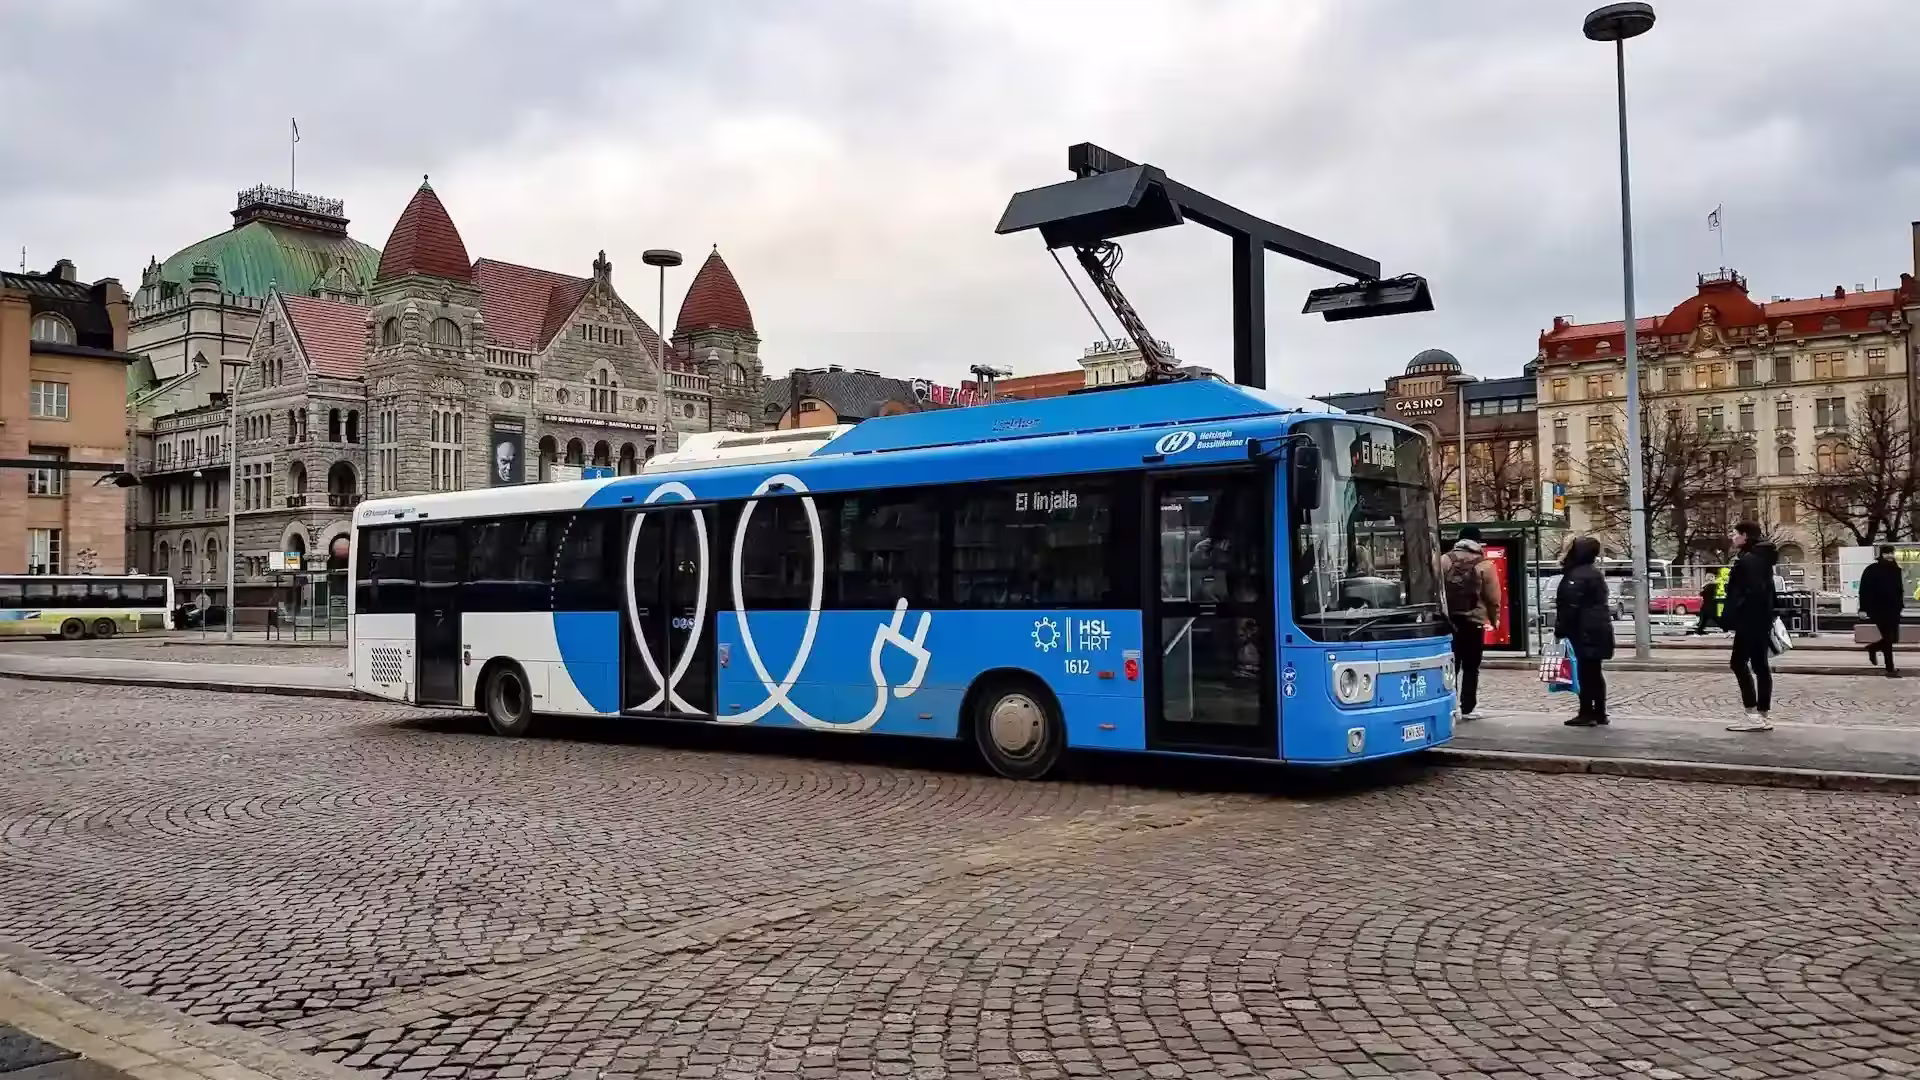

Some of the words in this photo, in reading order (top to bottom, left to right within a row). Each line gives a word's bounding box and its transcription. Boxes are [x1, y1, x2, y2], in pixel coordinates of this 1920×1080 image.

[1093, 338, 1130, 353] PLAZA
[1395, 398, 1443, 410] CASINO
[1199, 429, 1233, 441] Helsingin
[1015, 492, 1028, 511] Ei
[1033, 489, 1078, 513] linjalla
[1079, 620, 1112, 635] HSL
[1079, 635, 1111, 651] HRT
[1064, 659, 1091, 674] 1612
